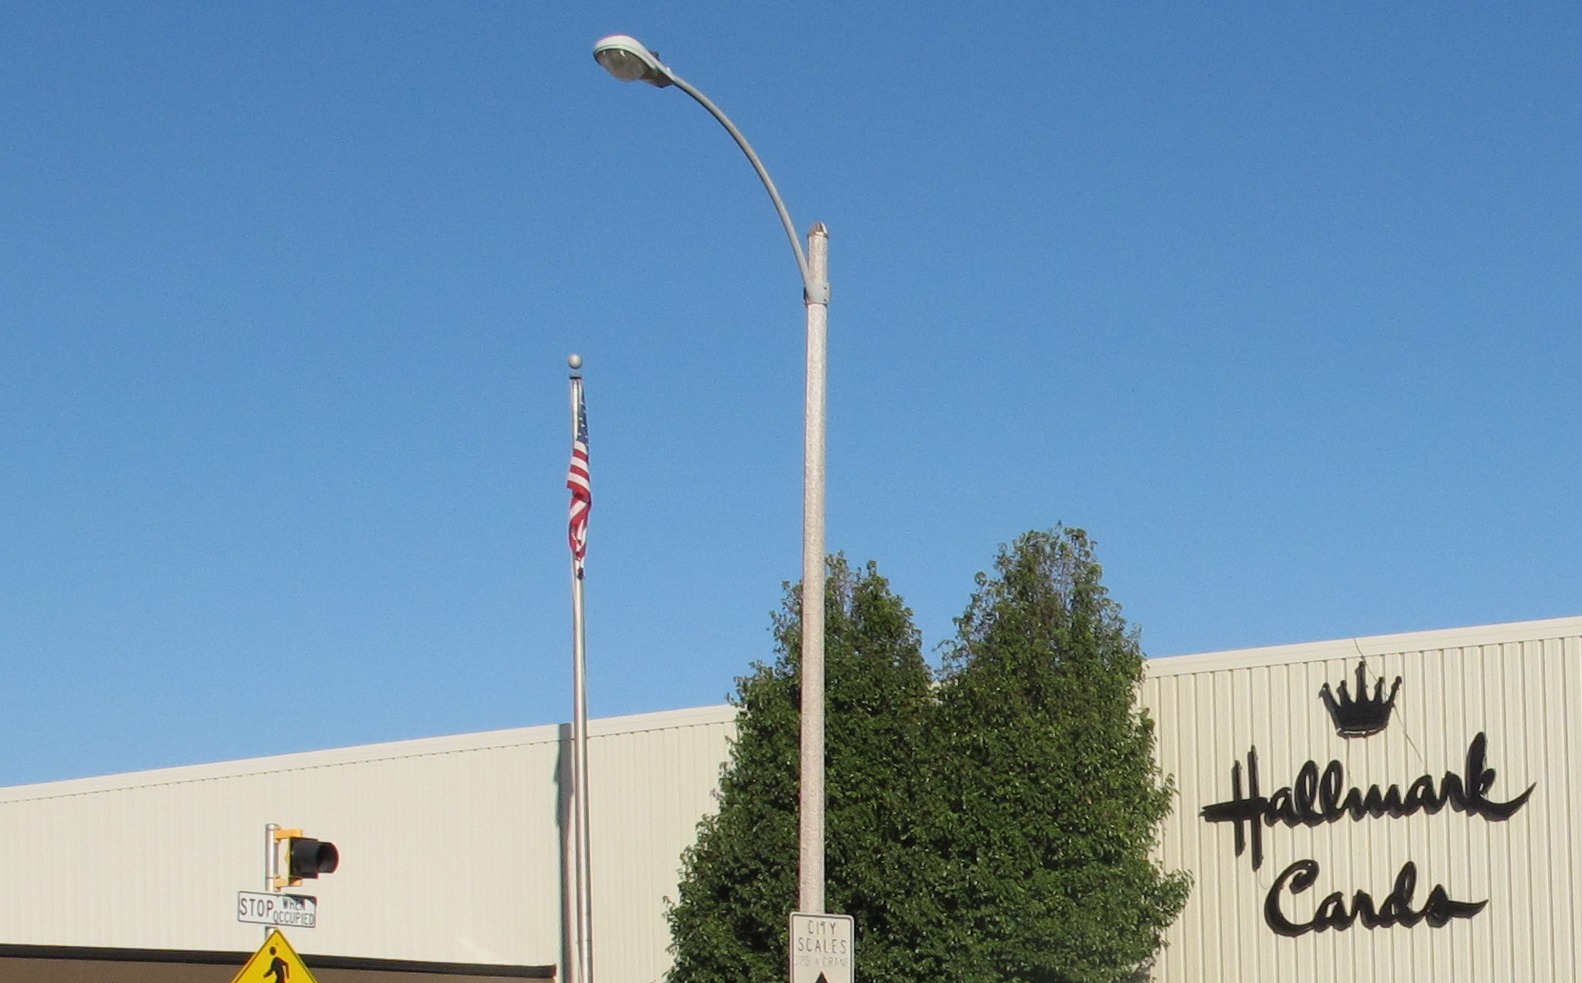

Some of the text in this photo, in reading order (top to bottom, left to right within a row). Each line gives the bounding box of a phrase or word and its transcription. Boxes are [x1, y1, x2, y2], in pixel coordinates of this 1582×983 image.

[1199, 732, 1536, 872] Hallmark
[240, 897, 274, 917] STOP
[282, 897, 306, 911] WHEN
[1264, 859, 1489, 937] Cards
[273, 910, 315, 926] OCCUPIED
[807, 919, 837, 935] CITY
[796, 936, 848, 954] SCALES
